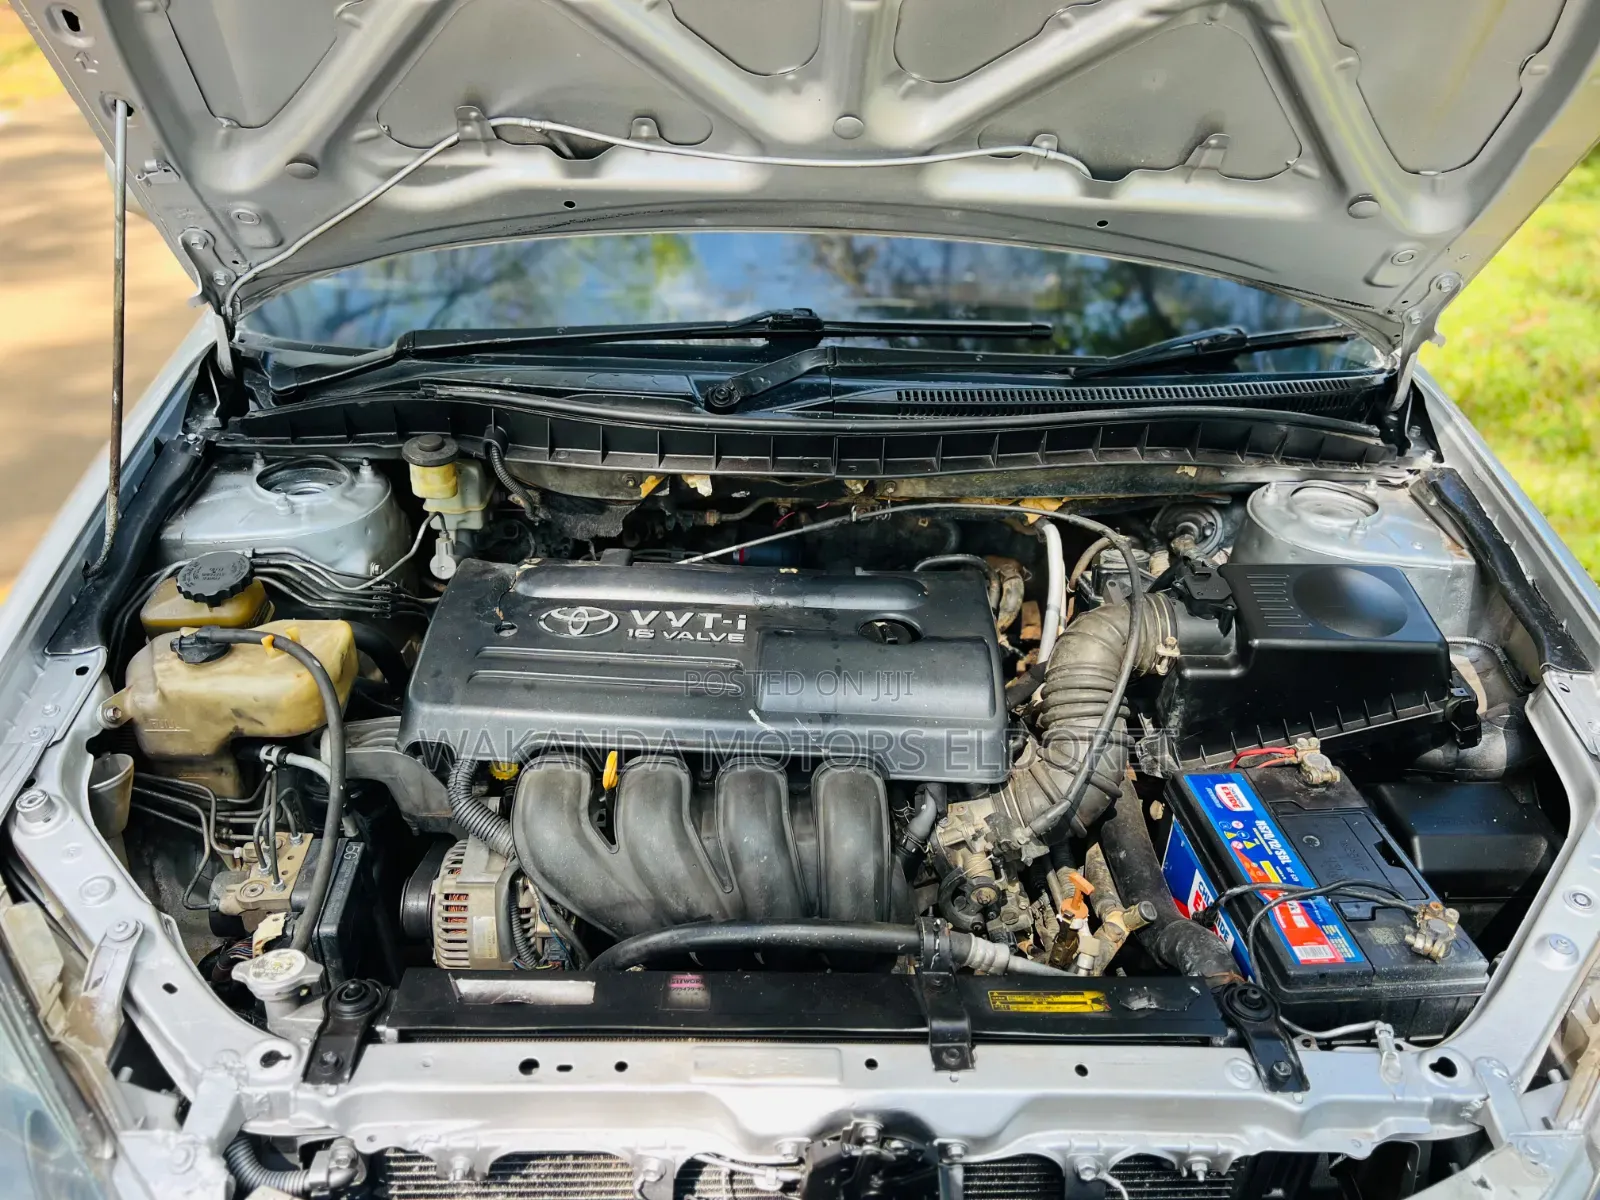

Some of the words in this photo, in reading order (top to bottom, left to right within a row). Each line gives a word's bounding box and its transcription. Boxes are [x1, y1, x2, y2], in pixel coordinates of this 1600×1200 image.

[631, 609, 747, 631] VVT-i
[626, 628, 655, 639] 16
[663, 630, 745, 643] VALVE
[1221, 786, 1241, 809] EXIDE
[343, 845, 360, 860] 5G
